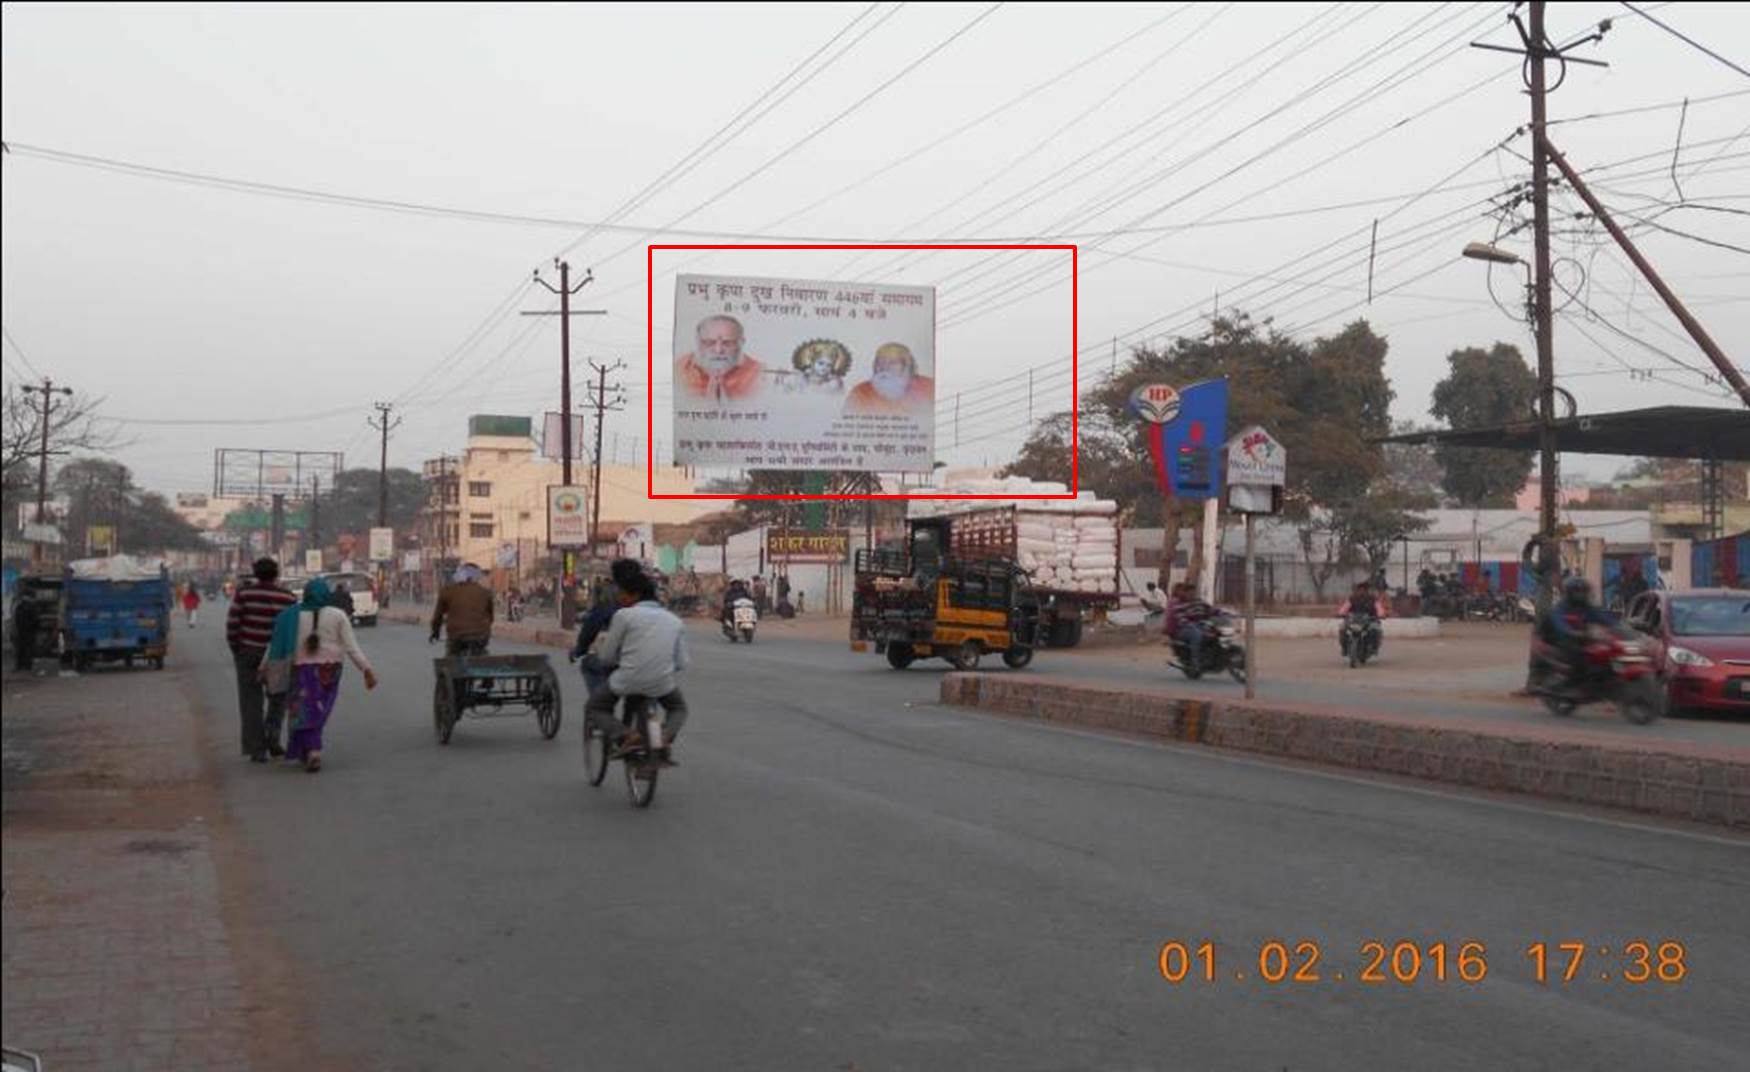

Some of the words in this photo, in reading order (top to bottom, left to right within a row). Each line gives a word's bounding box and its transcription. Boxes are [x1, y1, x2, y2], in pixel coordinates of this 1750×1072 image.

[687, 282, 710, 301] प्रभु
[716, 284, 744, 301] कृपा
[780, 284, 829, 302] निवारण
[1149, 387, 1172, 402] HP
